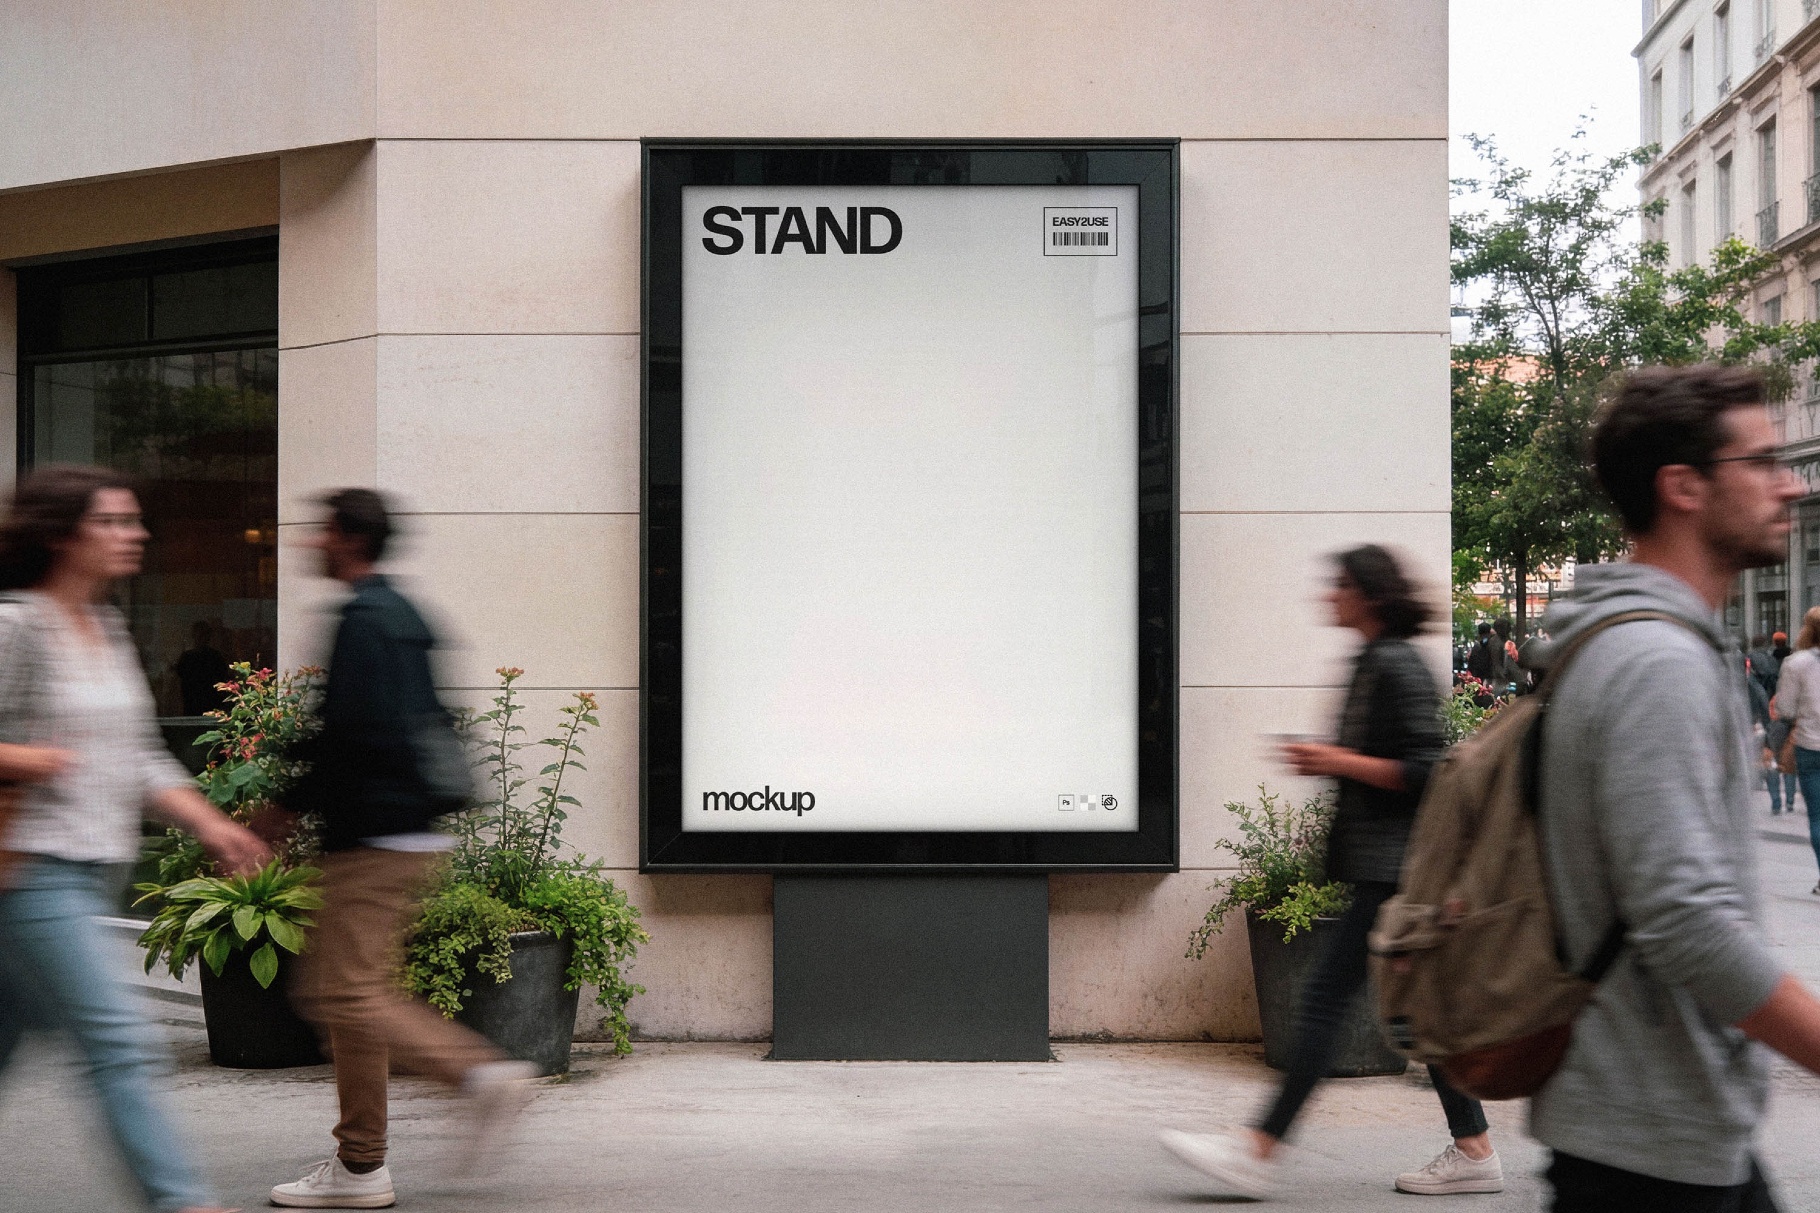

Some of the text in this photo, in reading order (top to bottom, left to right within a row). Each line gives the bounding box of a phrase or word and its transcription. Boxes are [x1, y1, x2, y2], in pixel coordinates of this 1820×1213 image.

[702, 206, 902, 256] STAND
[1052, 217, 1109, 227] EASY2USE
[703, 786, 815, 816] mockup
